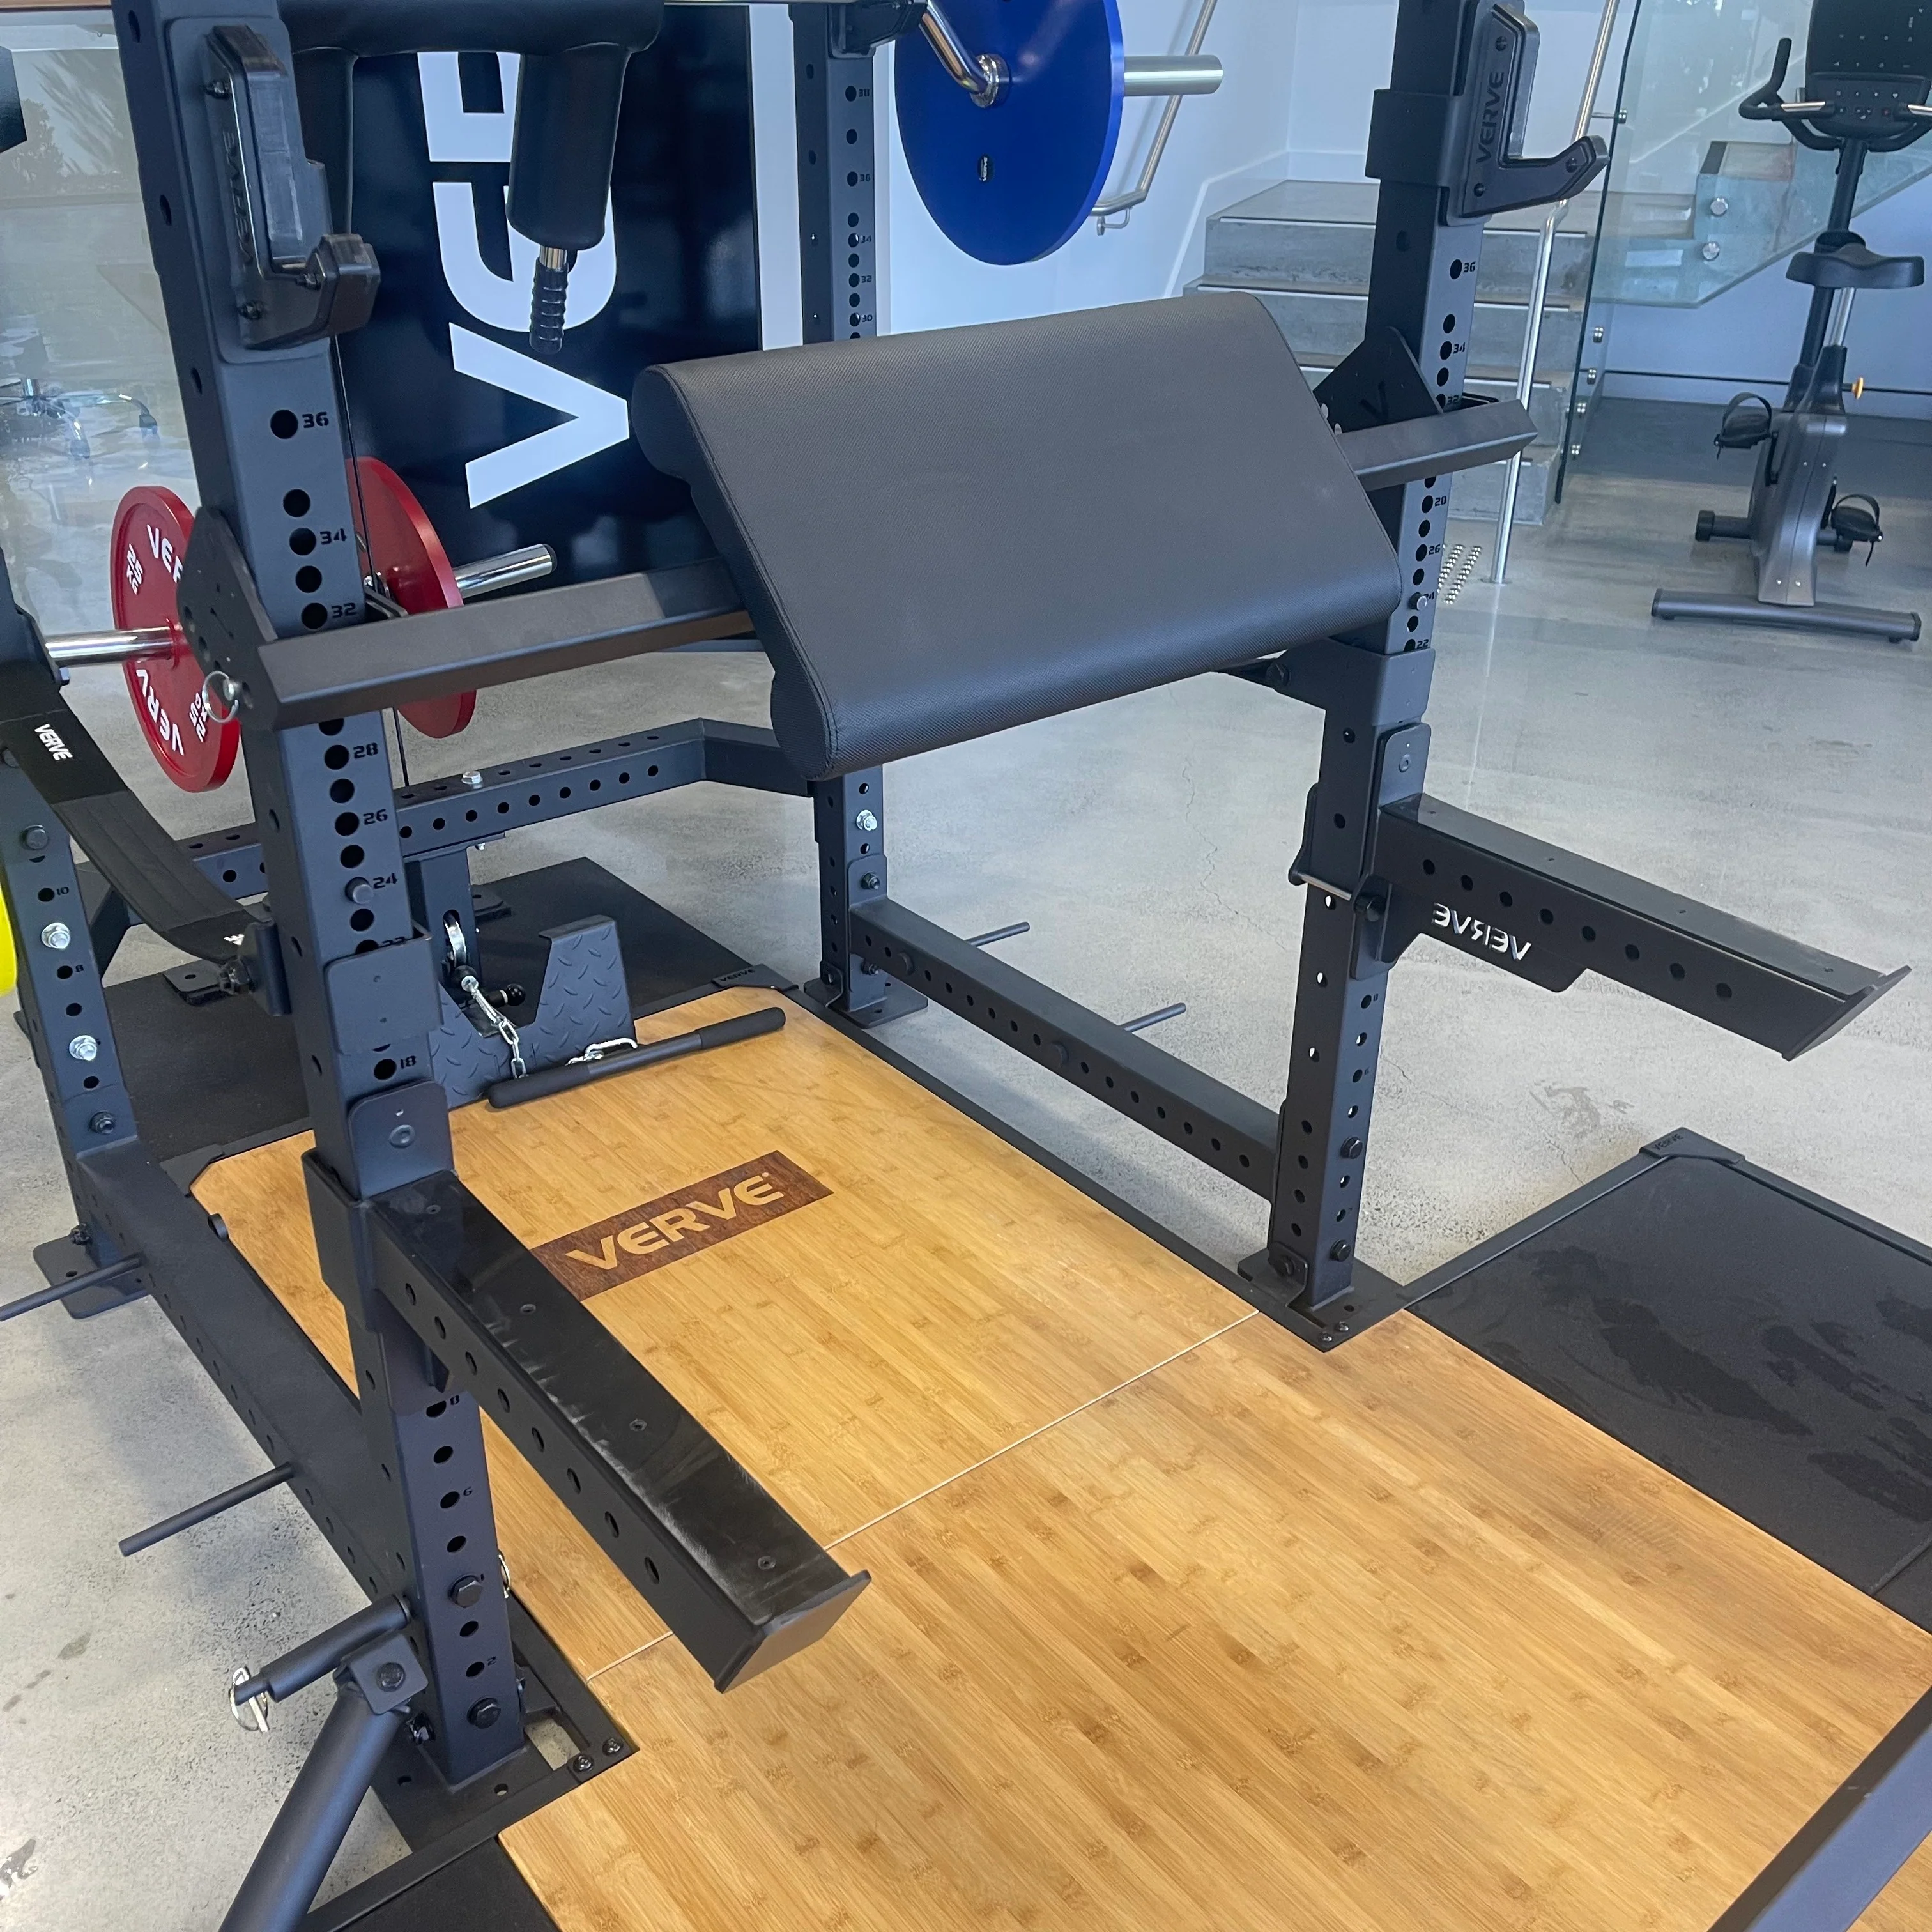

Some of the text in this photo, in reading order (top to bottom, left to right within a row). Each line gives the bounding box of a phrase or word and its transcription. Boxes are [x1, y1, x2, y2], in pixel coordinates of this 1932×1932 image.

[1476, 71, 1505, 164] VERVE
[859, 173, 871, 182] 36
[1463, 261, 1476, 273] 36
[861, 314, 873, 323] 30
[1453, 342, 1466, 355] 34
[1446, 395, 1459, 406] 32
[302, 412, 330, 428] 36
[320, 528, 348, 546] 34
[1429, 544, 1441, 555] 26
[127, 543, 143, 585] 25
[126, 564, 139, 595] KG
[332, 602, 357, 618] 32
[1416, 639, 1429, 649] 22
[189, 702, 206, 743] 25
[34, 723, 73, 761] VERVE
[353, 742, 379, 758] 28
[362, 809, 388, 825] 26
[373, 872, 399, 889] 24
[56, 886, 70, 896] 10
[75, 964, 84, 973] 8
[400, 1055, 417, 1069] 18
[565, 1172, 784, 1270] VERVE
[449, 1395, 460, 1406] 8
[487, 1656, 496, 1667] 2
